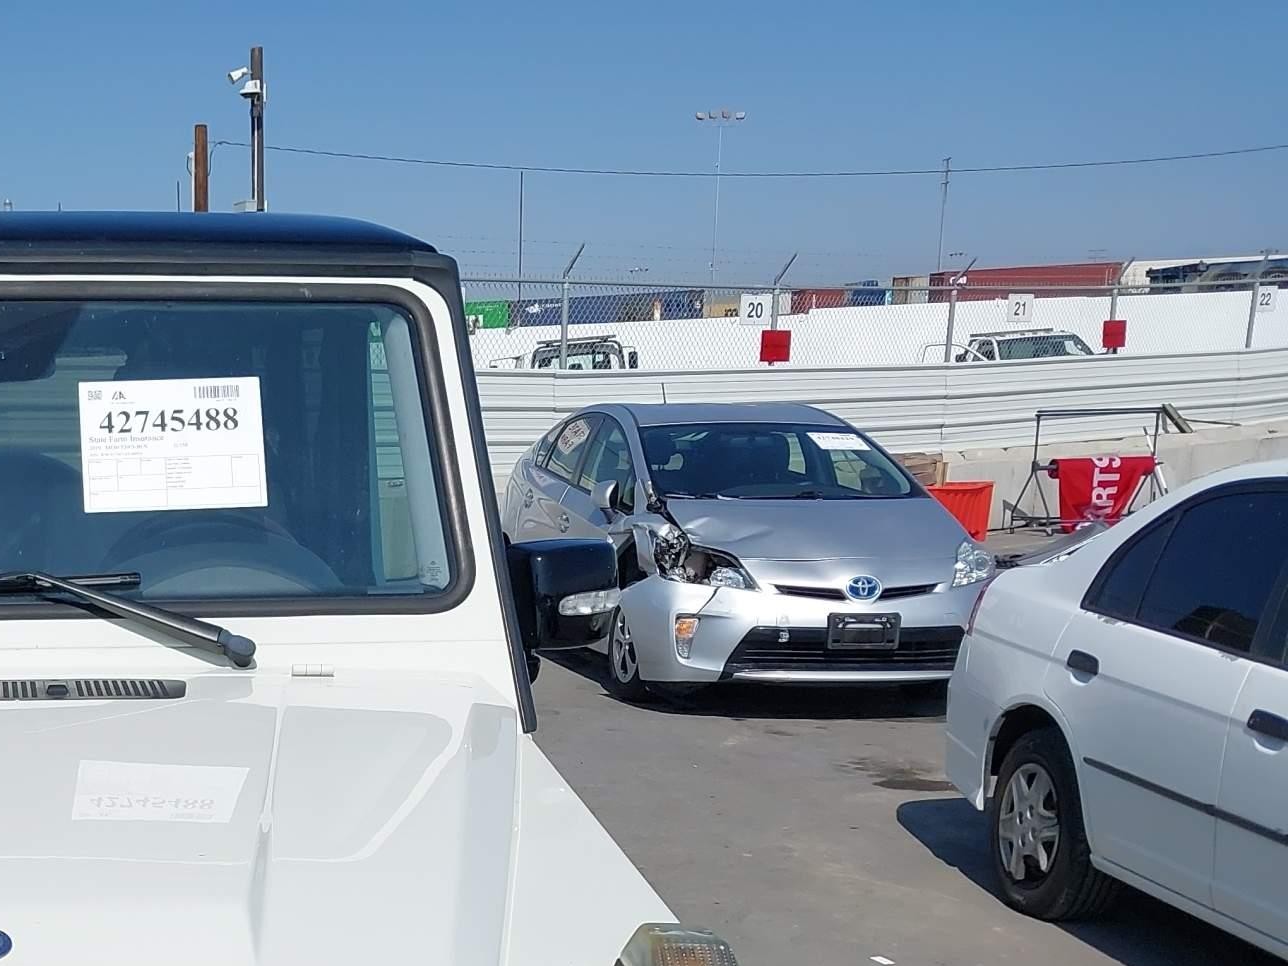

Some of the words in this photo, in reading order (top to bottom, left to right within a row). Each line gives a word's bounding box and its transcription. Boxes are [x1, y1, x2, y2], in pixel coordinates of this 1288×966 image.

[1259, 293, 1271, 306] 22
[747, 302, 764, 319] 20
[1014, 301, 1027, 316] 21
[99, 407, 239, 434] 42745488
